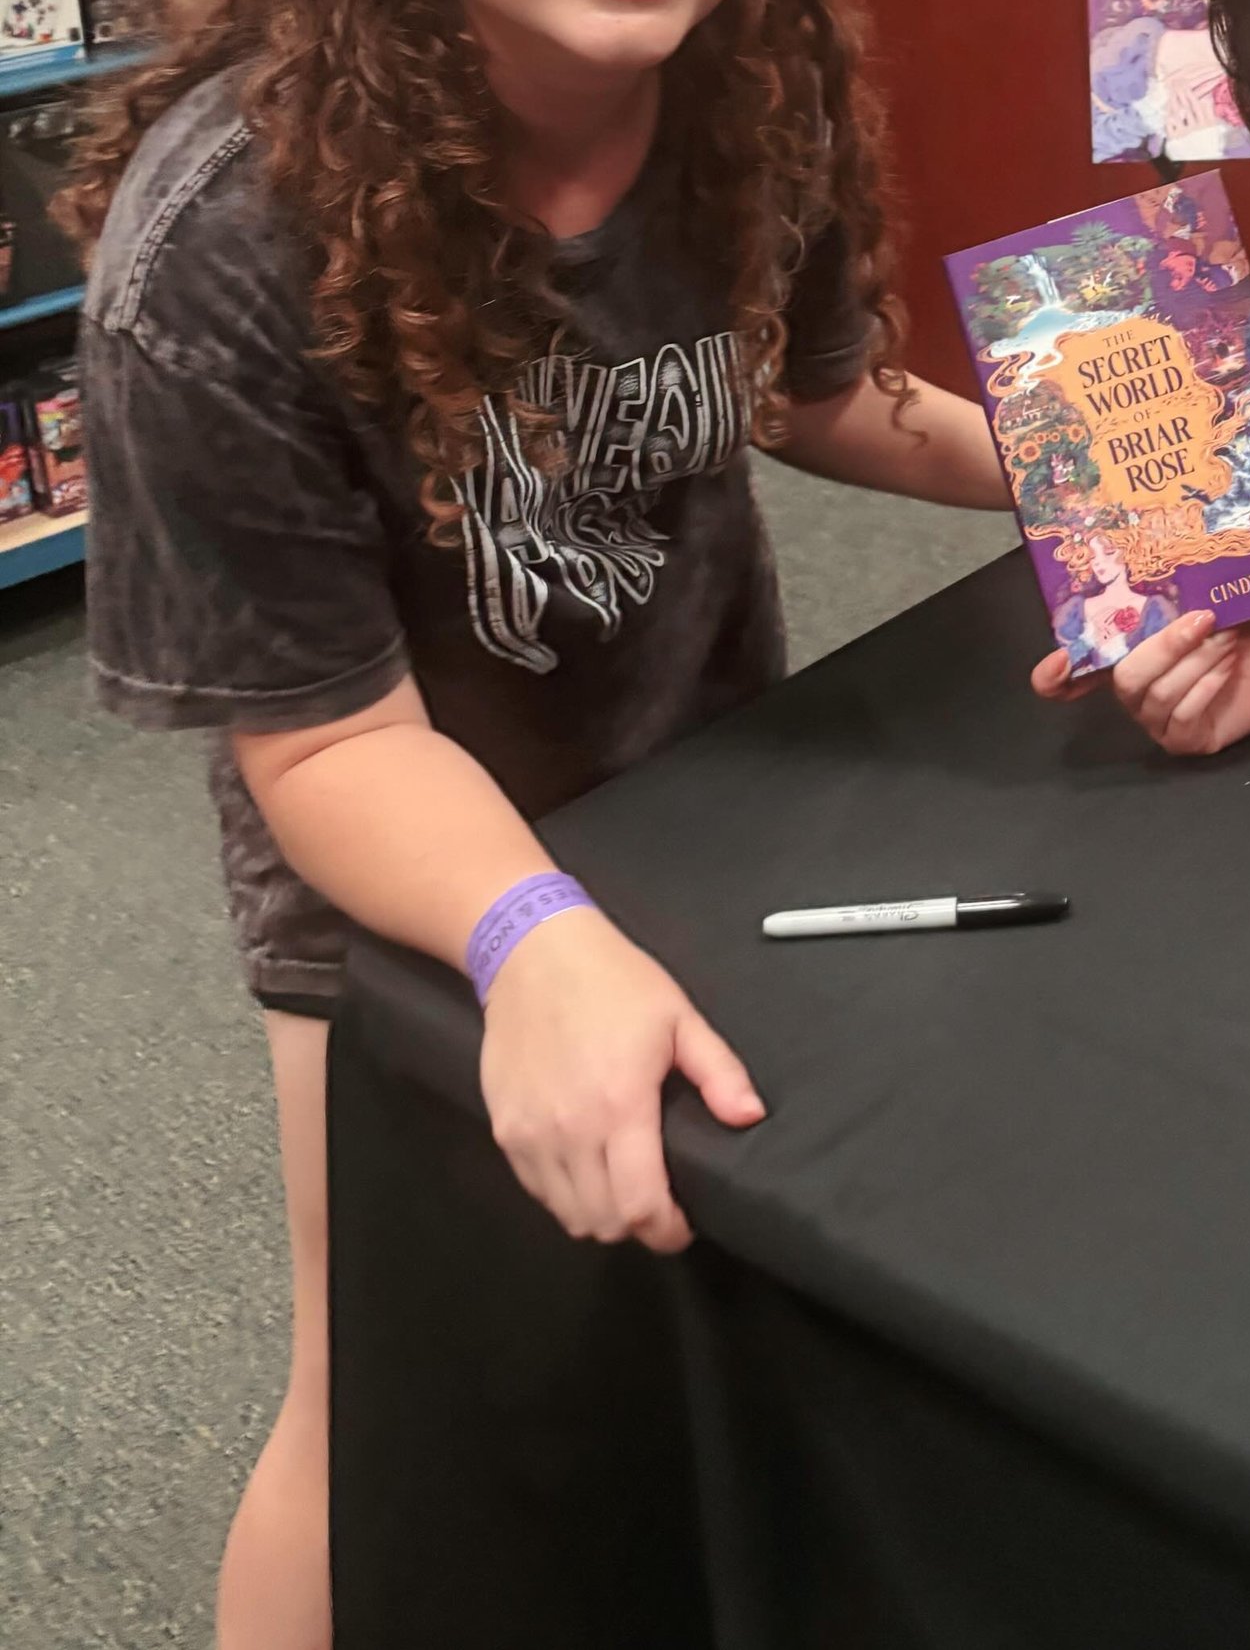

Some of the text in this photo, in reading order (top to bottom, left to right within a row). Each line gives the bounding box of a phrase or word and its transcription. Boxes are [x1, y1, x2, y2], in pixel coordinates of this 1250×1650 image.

[1078, 335, 1172, 389] SECRET
[1102, 330, 1135, 348] THE
[1085, 366, 1184, 416] WORLD
[1133, 408, 1155, 423] OF
[1107, 416, 1193, 465] BRIAR
[1125, 448, 1196, 492] ROSE
